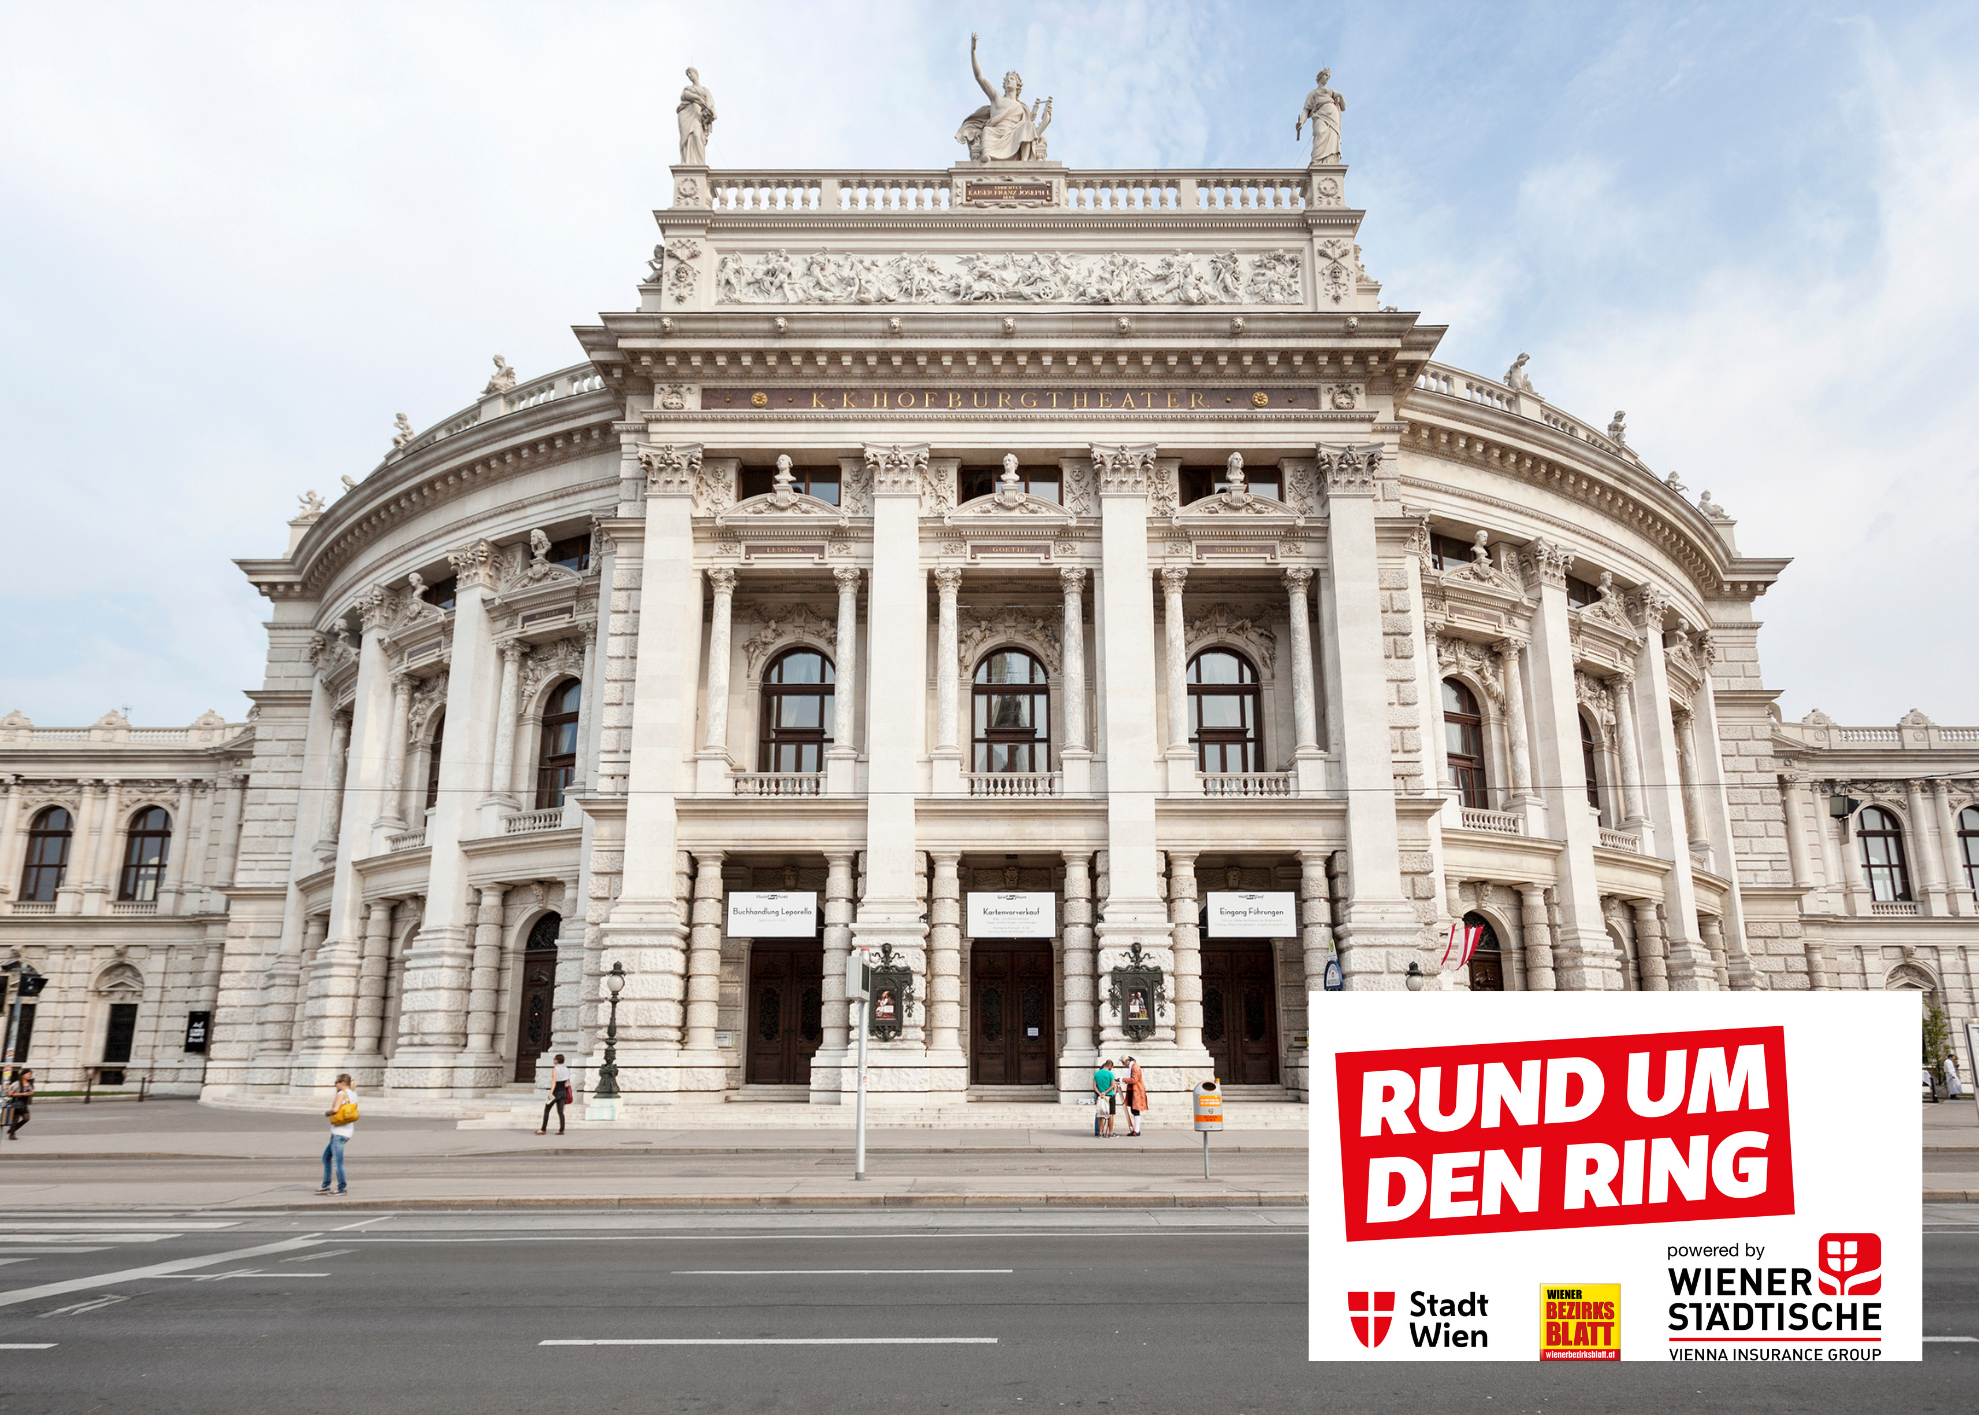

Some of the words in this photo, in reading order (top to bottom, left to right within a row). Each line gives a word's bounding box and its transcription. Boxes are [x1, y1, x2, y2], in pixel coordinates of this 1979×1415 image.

[732, 907, 779, 917] Buchhandlung
[781, 907, 812, 917] Leporello
[982, 907, 1040, 916] Kartenvorverkauf
[1219, 907, 1247, 917] Eingang
[1248, 907, 1284, 917] Führungen
